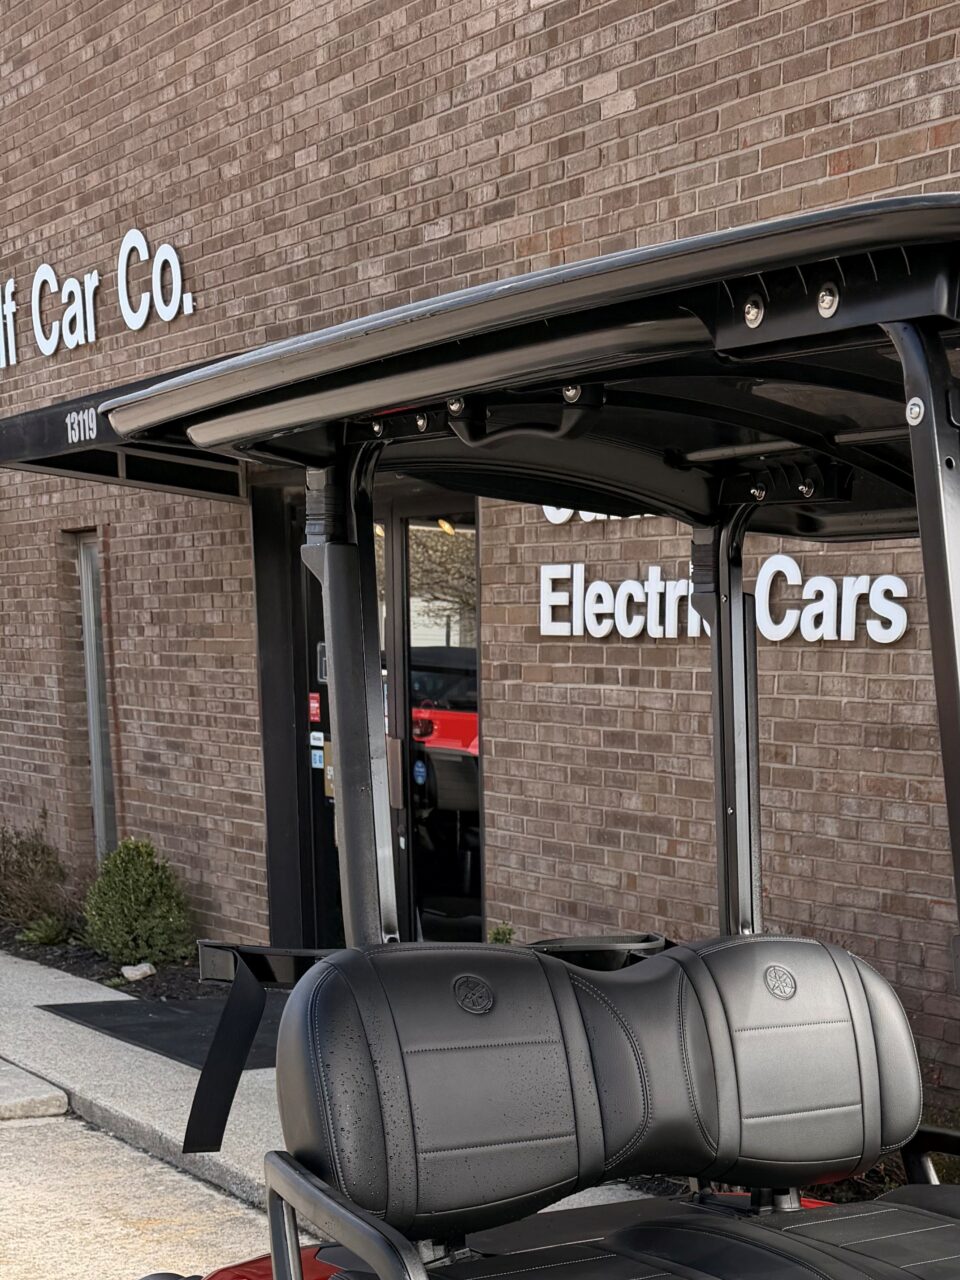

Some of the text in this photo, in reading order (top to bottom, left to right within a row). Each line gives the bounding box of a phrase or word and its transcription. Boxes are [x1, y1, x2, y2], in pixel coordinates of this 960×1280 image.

[31, 263, 99, 357] Car
[117, 228, 194, 331] Co.
[65, 407, 97, 444] 13119
[540, 554, 908, 644] Electri Cars
